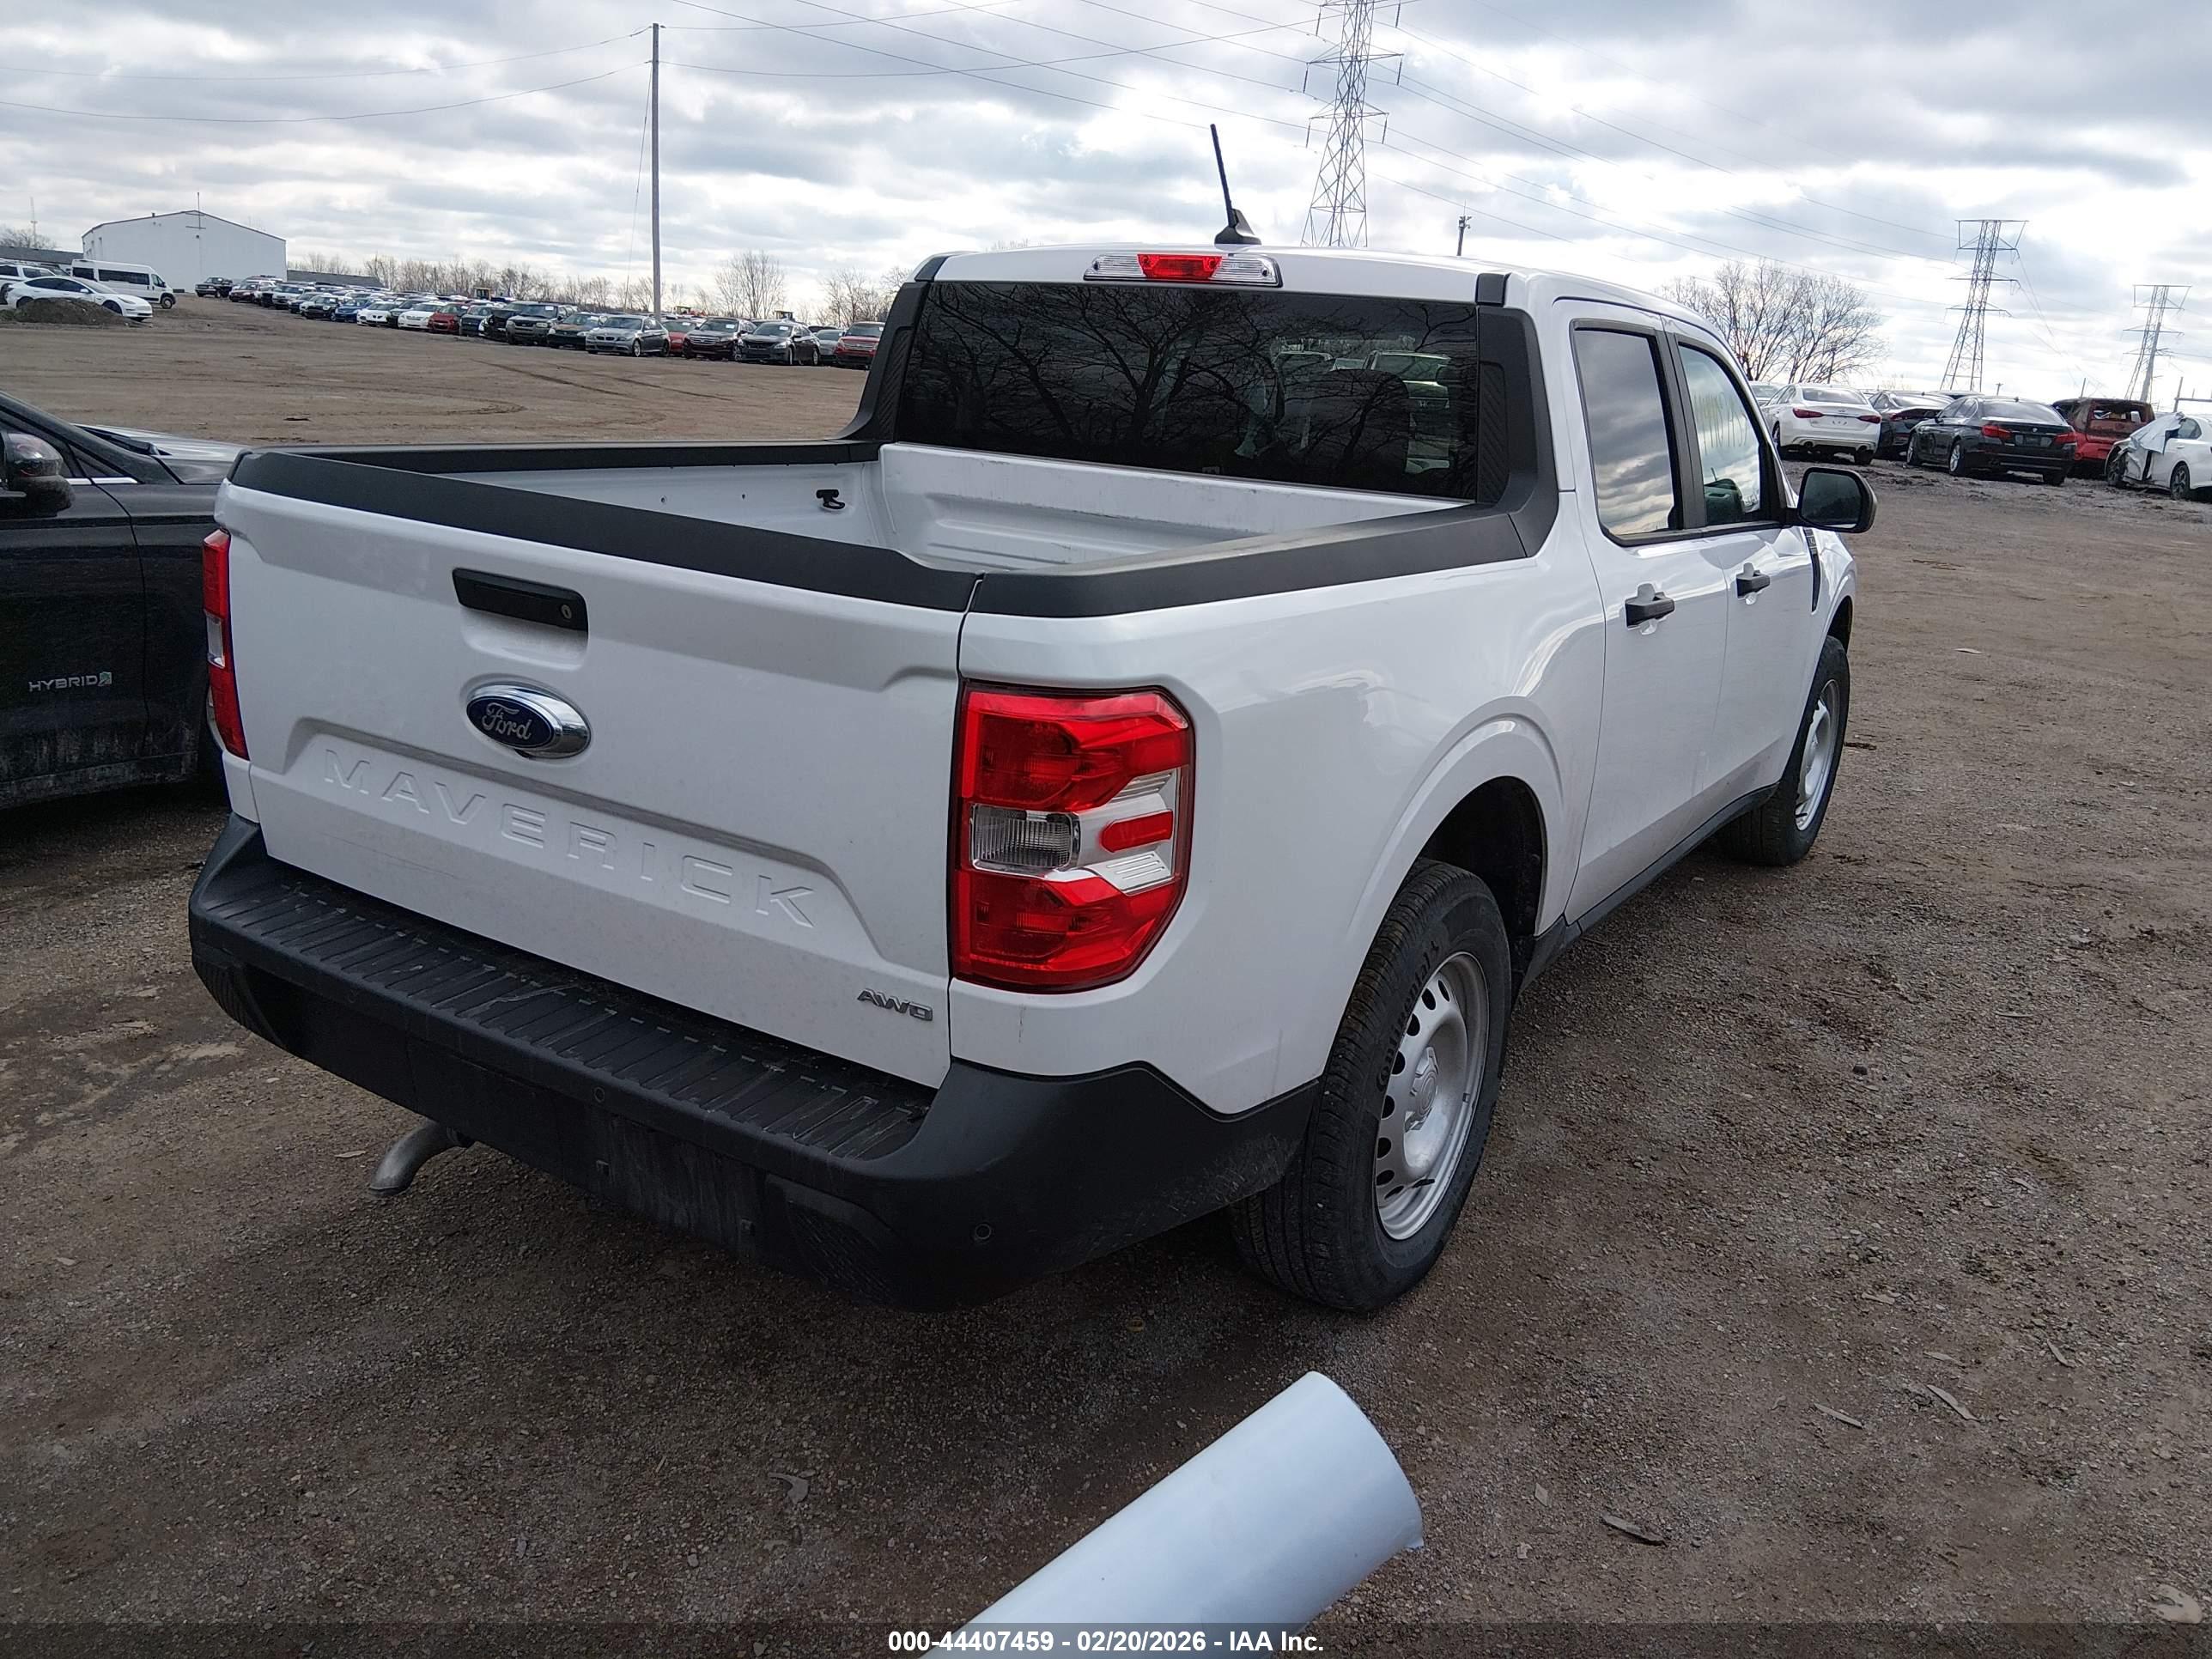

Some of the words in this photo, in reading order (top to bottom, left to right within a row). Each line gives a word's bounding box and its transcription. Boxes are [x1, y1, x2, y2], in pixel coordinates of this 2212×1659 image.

[28, 675, 98, 692] HYBRID
[481, 702, 533, 740] Ford
[324, 749, 814, 928] MAVERICK
[857, 988, 933, 1021] AWD
